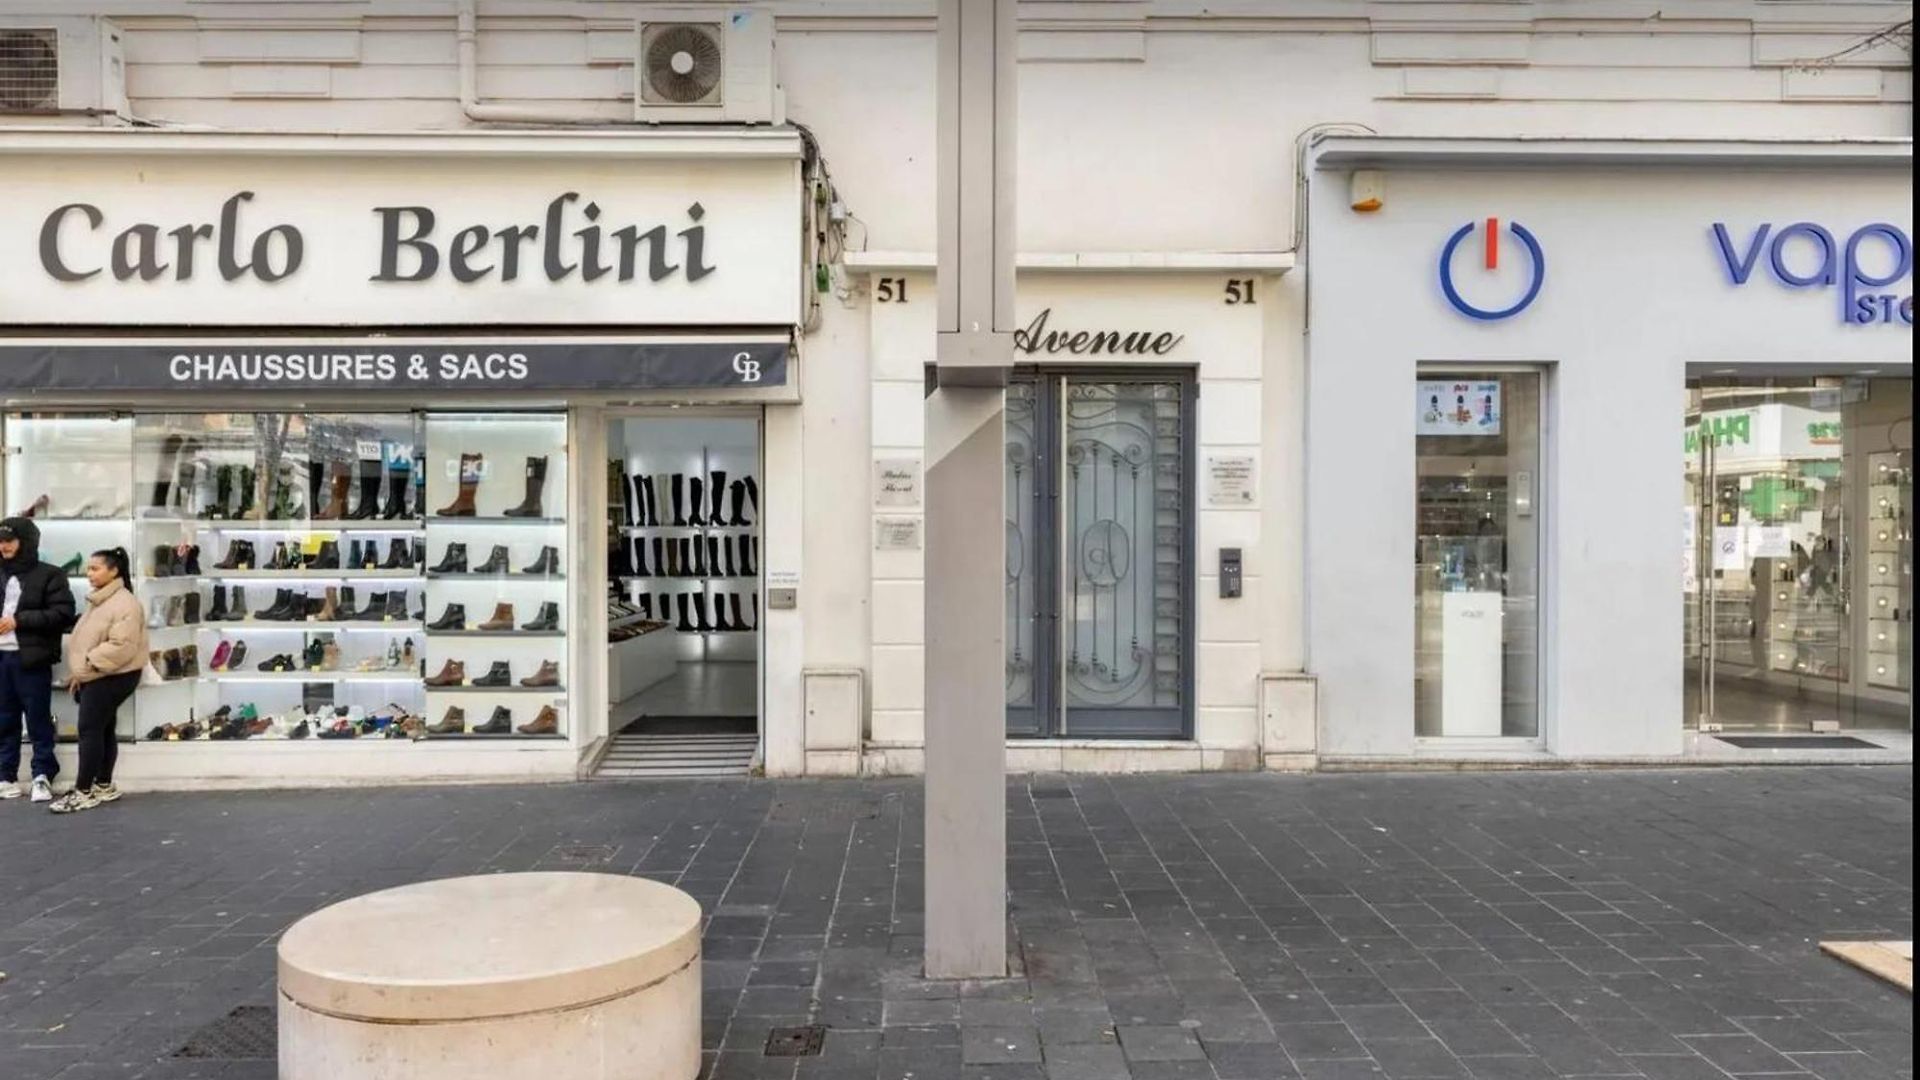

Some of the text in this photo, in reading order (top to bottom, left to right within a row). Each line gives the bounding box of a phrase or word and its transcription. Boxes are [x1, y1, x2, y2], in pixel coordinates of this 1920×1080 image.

[39, 191, 716, 283] Carlo Berlini
[878, 278, 908, 303] 51
[1225, 279, 1256, 304] 51
[1014, 308, 1184, 356] Avenue
[169, 354, 529, 381] CHAUSSURES & SACS
